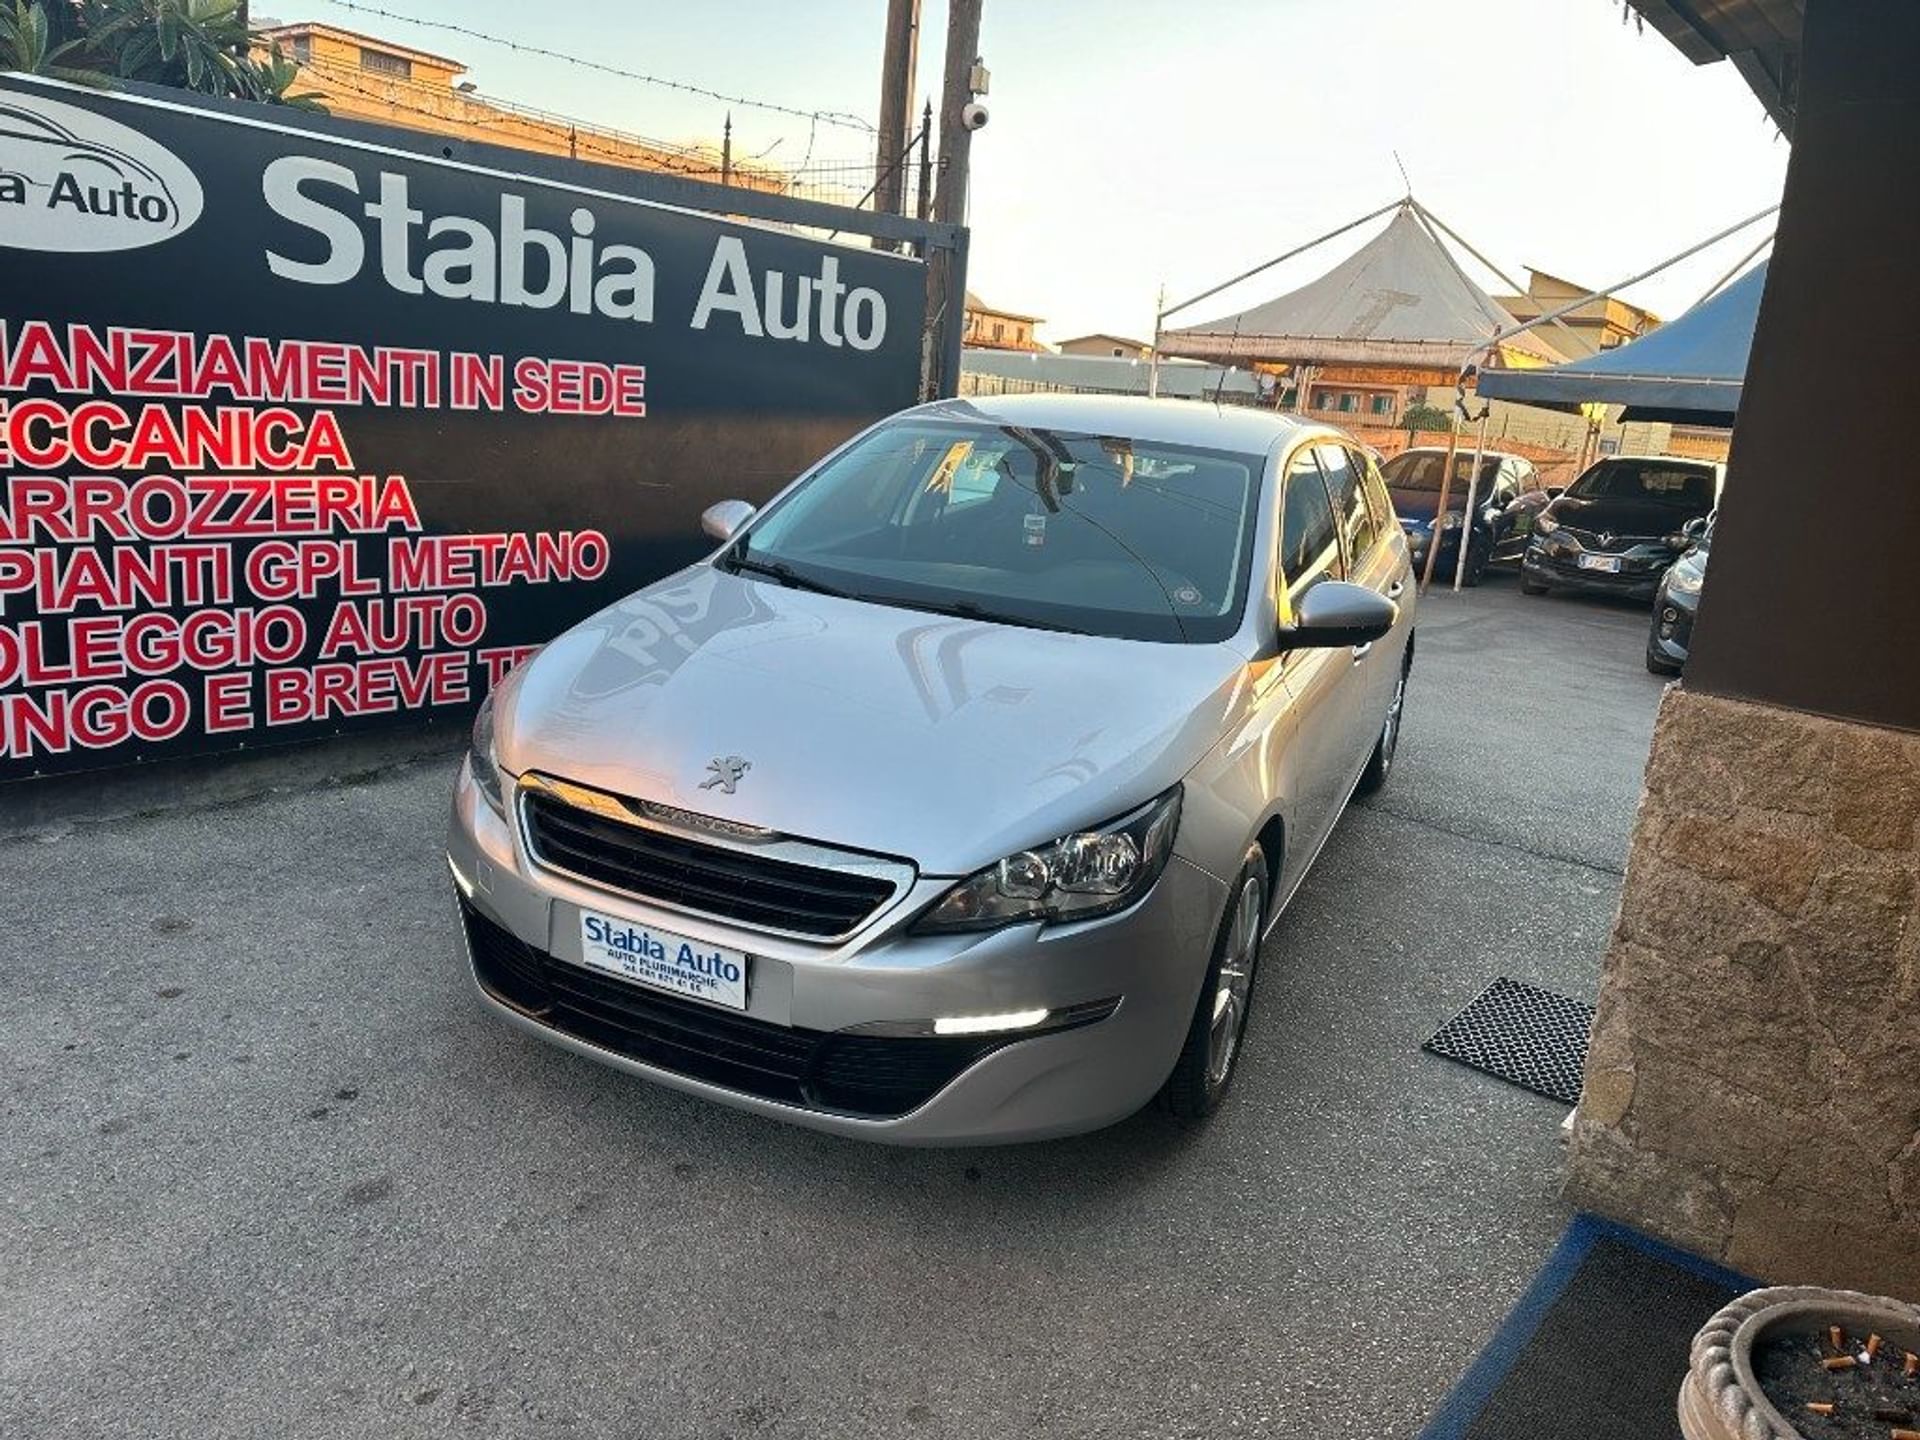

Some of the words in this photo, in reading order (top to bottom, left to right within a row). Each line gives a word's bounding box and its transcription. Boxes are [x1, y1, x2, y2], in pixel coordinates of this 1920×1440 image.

[47, 172, 168, 222] Auto
[262, 155, 655, 323] Stabia
[690, 234, 887, 351] Auto
[0, 319, 440, 408] ANZIAMENTI
[450, 351, 504, 411] IN
[512, 356, 646, 417] SEDE
[0, 398, 355, 471] CCANICA
[0, 475, 423, 544] RROZZERIA
[245, 540, 381, 601] GPL
[389, 530, 609, 593] METANO
[318, 593, 487, 659] AUTO
[0, 678, 191, 759] NGO
[205, 672, 254, 734] E
[266, 651, 471, 727] BREVE
[585, 916, 665, 961] Stabia
[676, 943, 740, 983] Auto
[607, 948, 637, 964] AUTO
